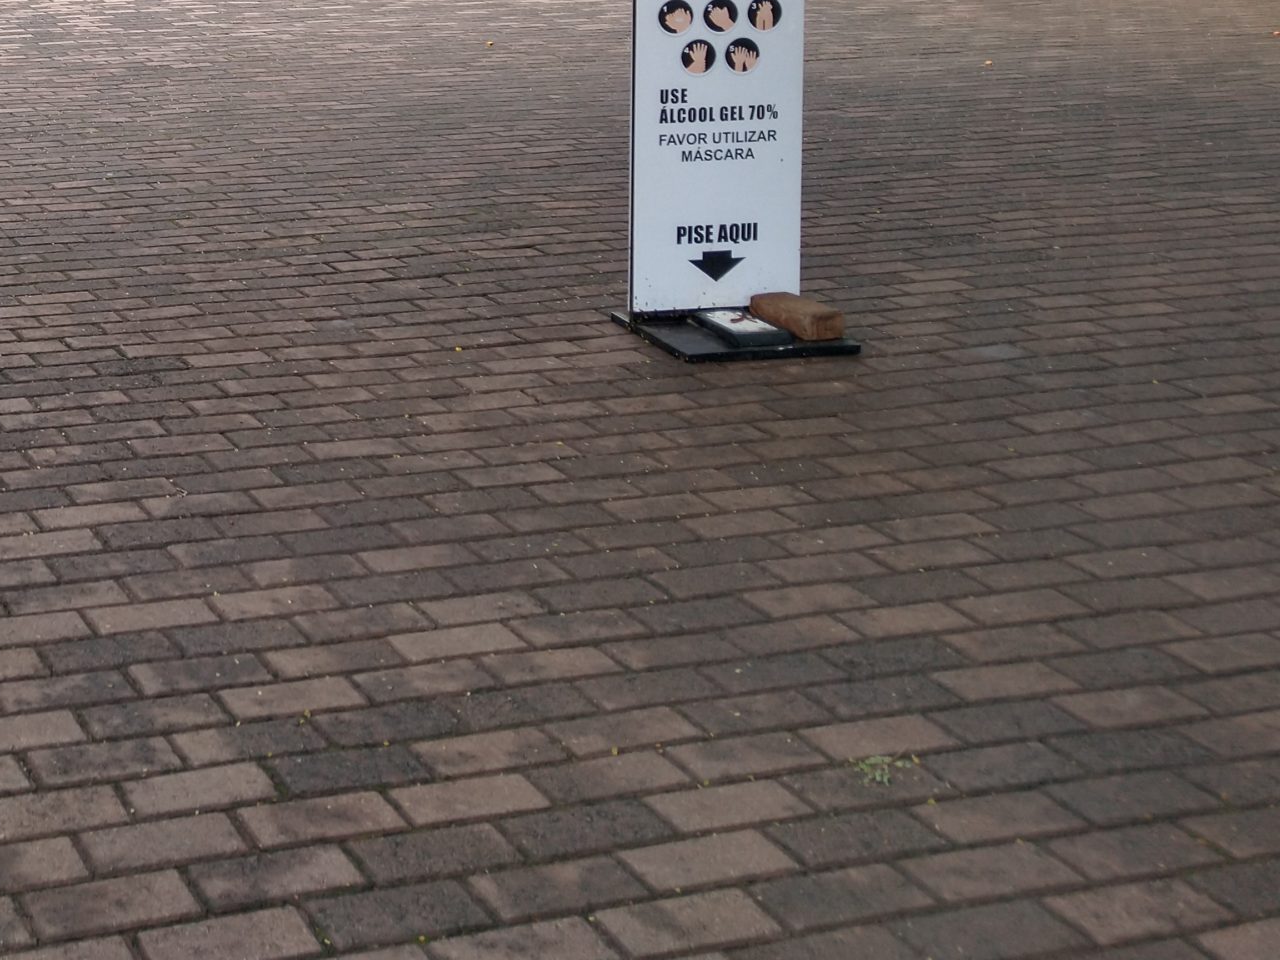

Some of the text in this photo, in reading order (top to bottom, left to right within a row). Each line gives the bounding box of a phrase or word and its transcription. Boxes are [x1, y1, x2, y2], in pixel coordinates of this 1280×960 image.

[660, 89, 688, 104] USE
[659, 104, 778, 123] ÁLCOOL GEL 70%
[659, 130, 777, 146] FAVOR UTILIZAR
[681, 147, 755, 162] MÁSCARA
[677, 222, 758, 244] PISE AQUI
